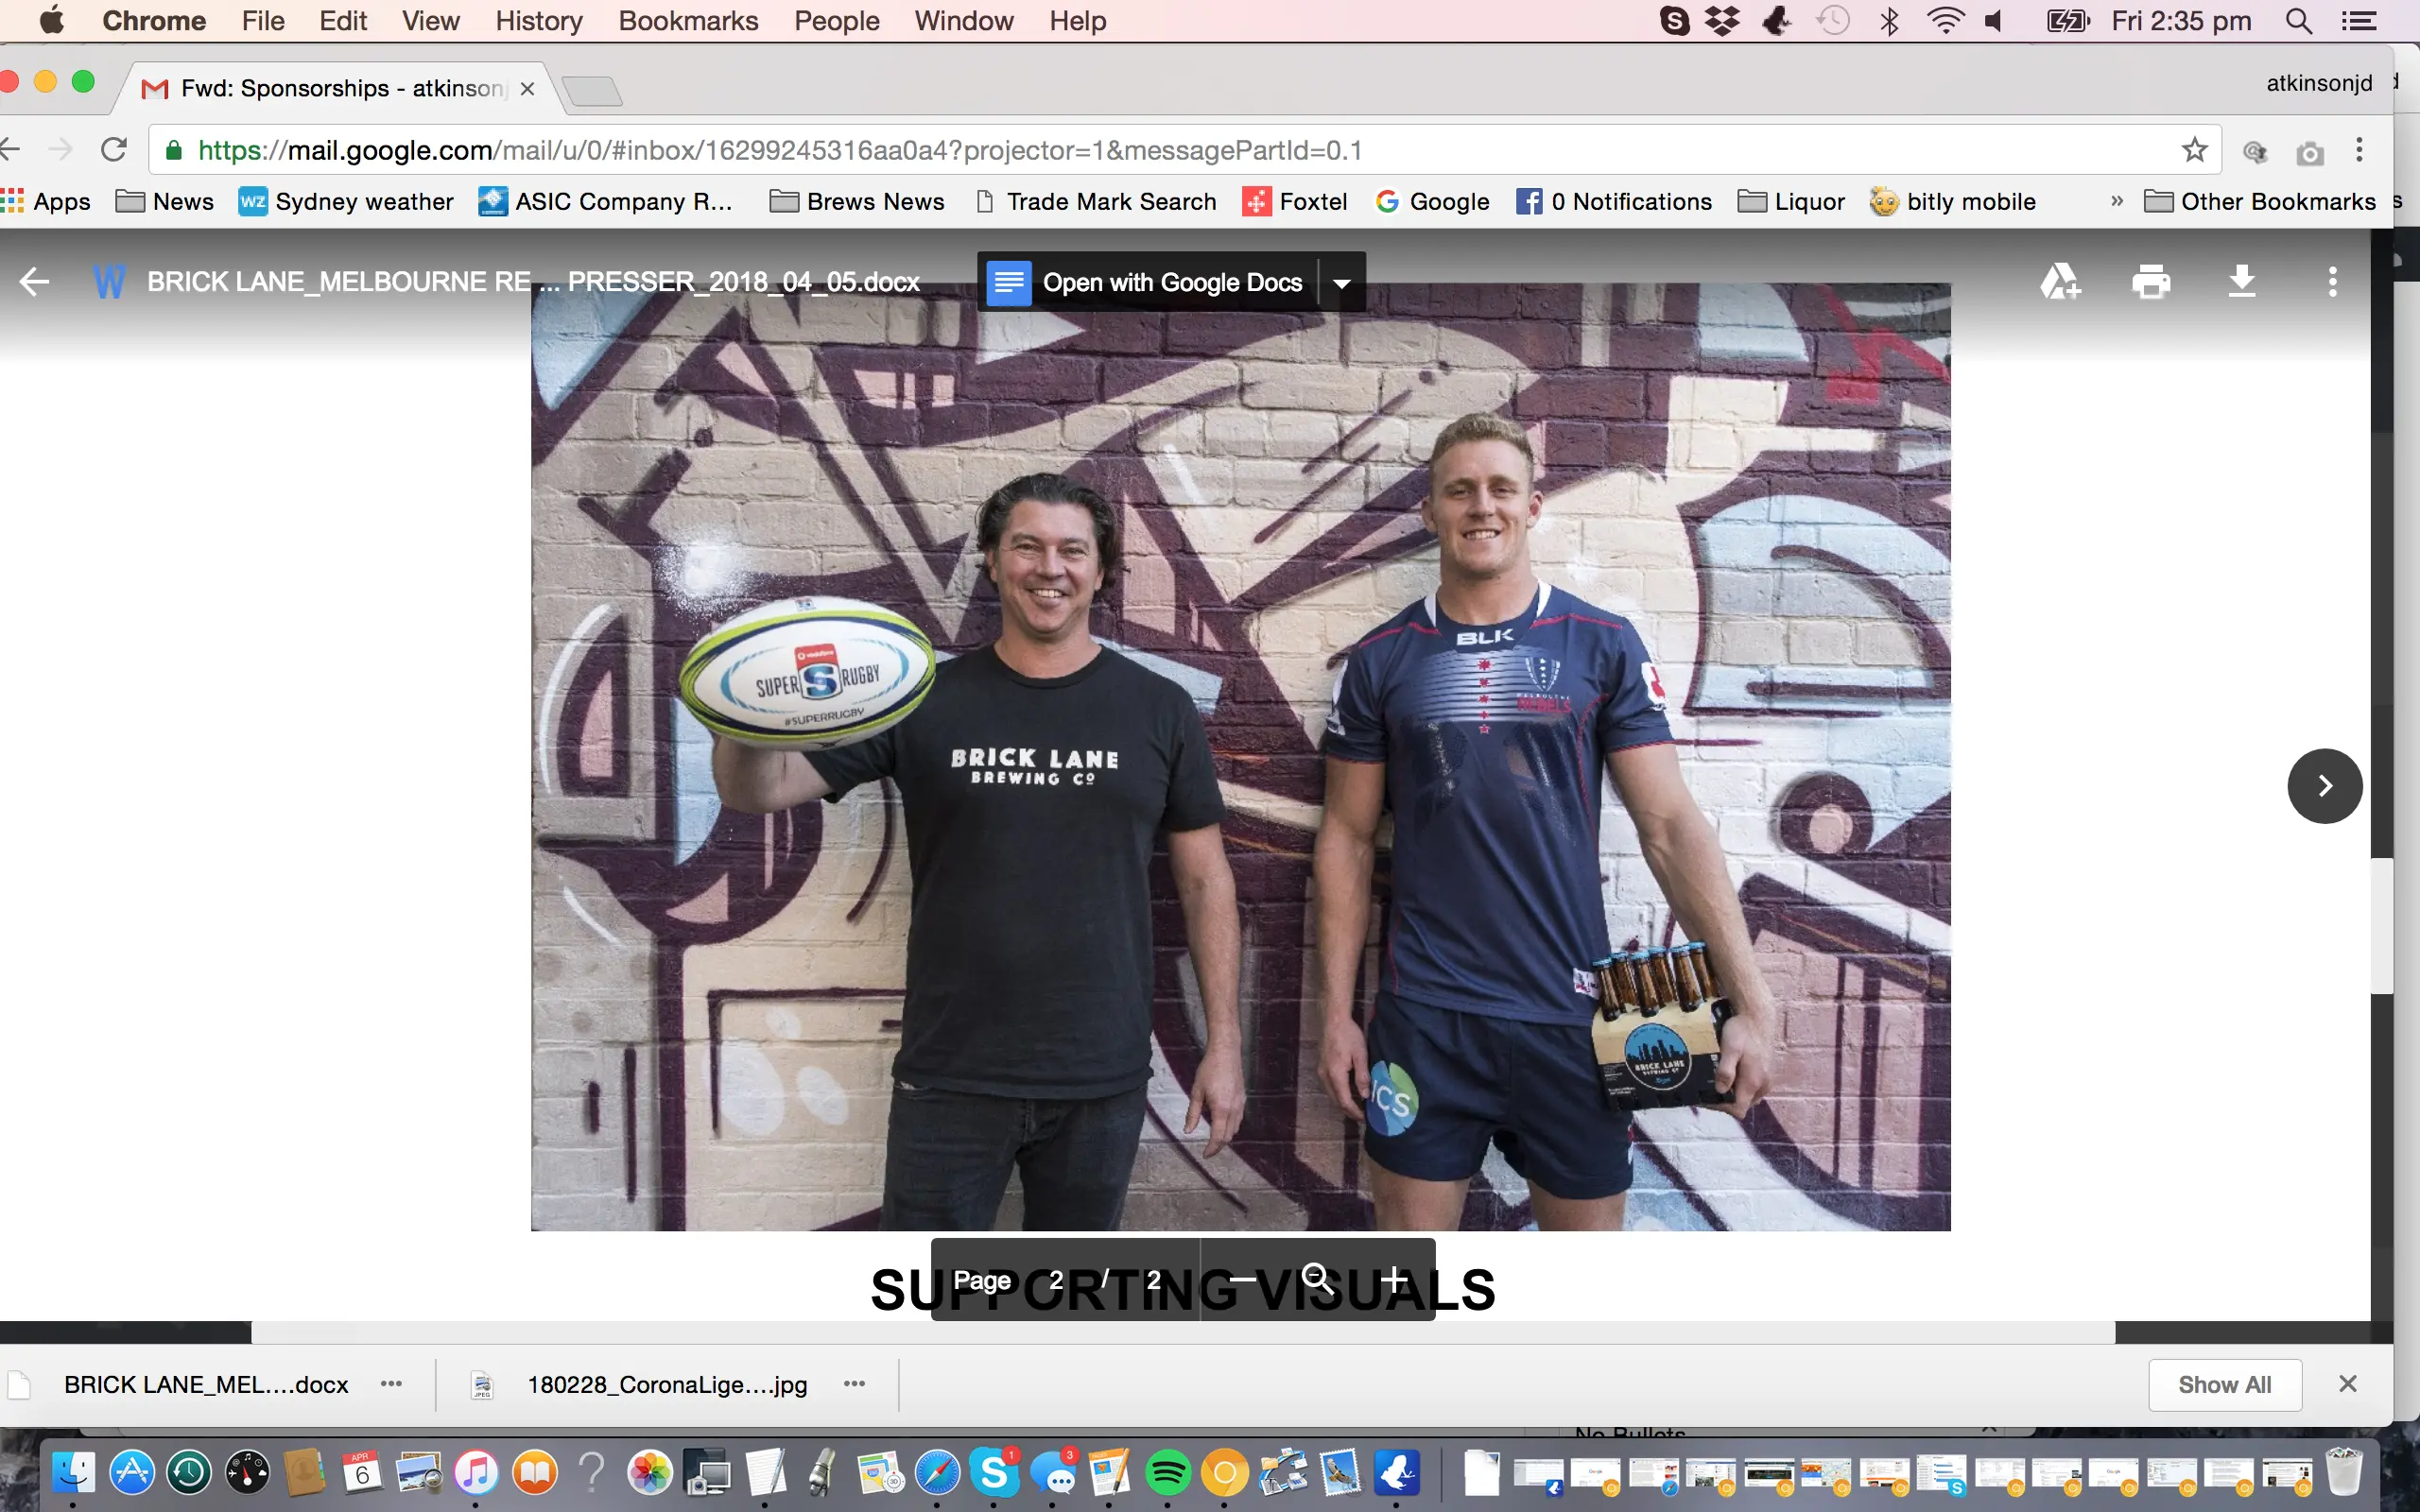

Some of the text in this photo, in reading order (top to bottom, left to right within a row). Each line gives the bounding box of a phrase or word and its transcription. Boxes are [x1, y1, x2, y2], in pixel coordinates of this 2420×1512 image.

[103, 10, 206, 30] Chrome
[244, 10, 285, 30] File
[321, 10, 367, 30] Edit
[403, 10, 460, 30] View
[497, 10, 583, 36] History
[620, 10, 758, 30] Bookmarks
[796, 10, 879, 36] People
[915, 10, 1014, 30] Window
[1051, 10, 1106, 36] Help
[2114, 10, 2251, 36] Fri 2:35 pm
[183, 79, 233, 96] Fwd:
[242, 78, 389, 101] Sponsorships
[2268, 75, 2373, 95] atkinsonjd
[199, 138, 1363, 165] https://mail.google.com/mail/u/0/#inbox/16299245316aa0a4?projector=1&messagePartId=0.1
[34, 193, 91, 215] Apps
[154, 193, 215, 210] News
[277, 193, 454, 215] Sydney weather
[516, 193, 570, 210] ASIC
[580, 193, 686, 215] Company
[808, 193, 945, 210] Brews News
[1008, 193, 1217, 210] Trade Mark Search
[1281, 193, 1347, 210] Foxtel
[1410, 193, 1490, 215] Google
[1553, 193, 1713, 210] 0 Notifications
[1776, 193, 1845, 215] Liquor
[1908, 193, 2036, 215] bitly mobile
[2182, 193, 2243, 210] Other
[2253, 193, 2377, 210] Bookmarks
[148, 271, 230, 291] BRICK
[237, 271, 487, 297] LANE_MELBOURNE
[496, 271, 531, 291] RE
[570, 271, 921, 297] PRESSER_2018_04_05.docx
[1045, 272, 1303, 297] Open with Google Docs
[1457, 628, 1514, 645] BLK
[756, 675, 801, 698] SUPER
[841, 663, 880, 687] RUGBY
[785, 707, 865, 727] #SUPERRUGBY
[951, 747, 1118, 769] BRICK LANE
[971, 771, 1060, 785] BREWING
[1634, 1059, 1685, 1072] BRICK LANE
[956, 1271, 1011, 1295] Page
[1050, 1271, 1063, 1289] 2
[1148, 1271, 1161, 1289] 2
[65, 1376, 137, 1394] BRICK
[2179, 1376, 2272, 1394] Show All
[352, 1452, 369, 1463] APR
[1067, 1451, 1074, 1459] 3
[355, 1466, 370, 1485] 6
